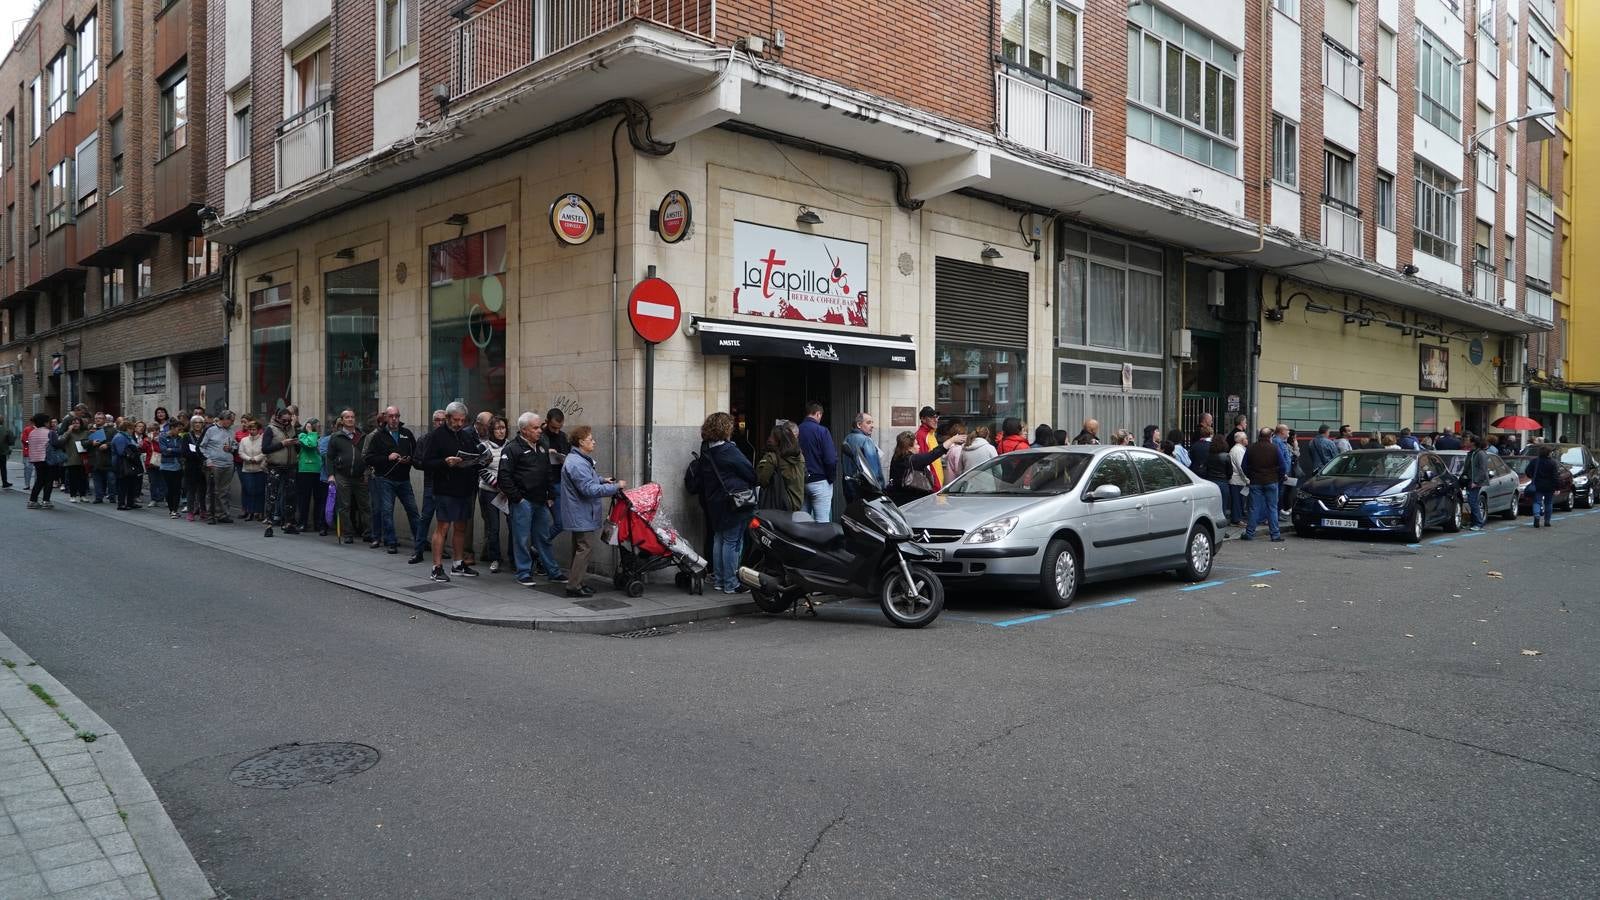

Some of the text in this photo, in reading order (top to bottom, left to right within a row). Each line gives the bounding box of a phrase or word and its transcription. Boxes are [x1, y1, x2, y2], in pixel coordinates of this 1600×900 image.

[561, 213, 585, 223] AMSTEL
[666, 211, 683, 219] AMSTEL
[791, 292, 809, 301] BEER
[816, 296, 840, 304] COFFEE
[719, 339, 741, 347] AMSTEL
